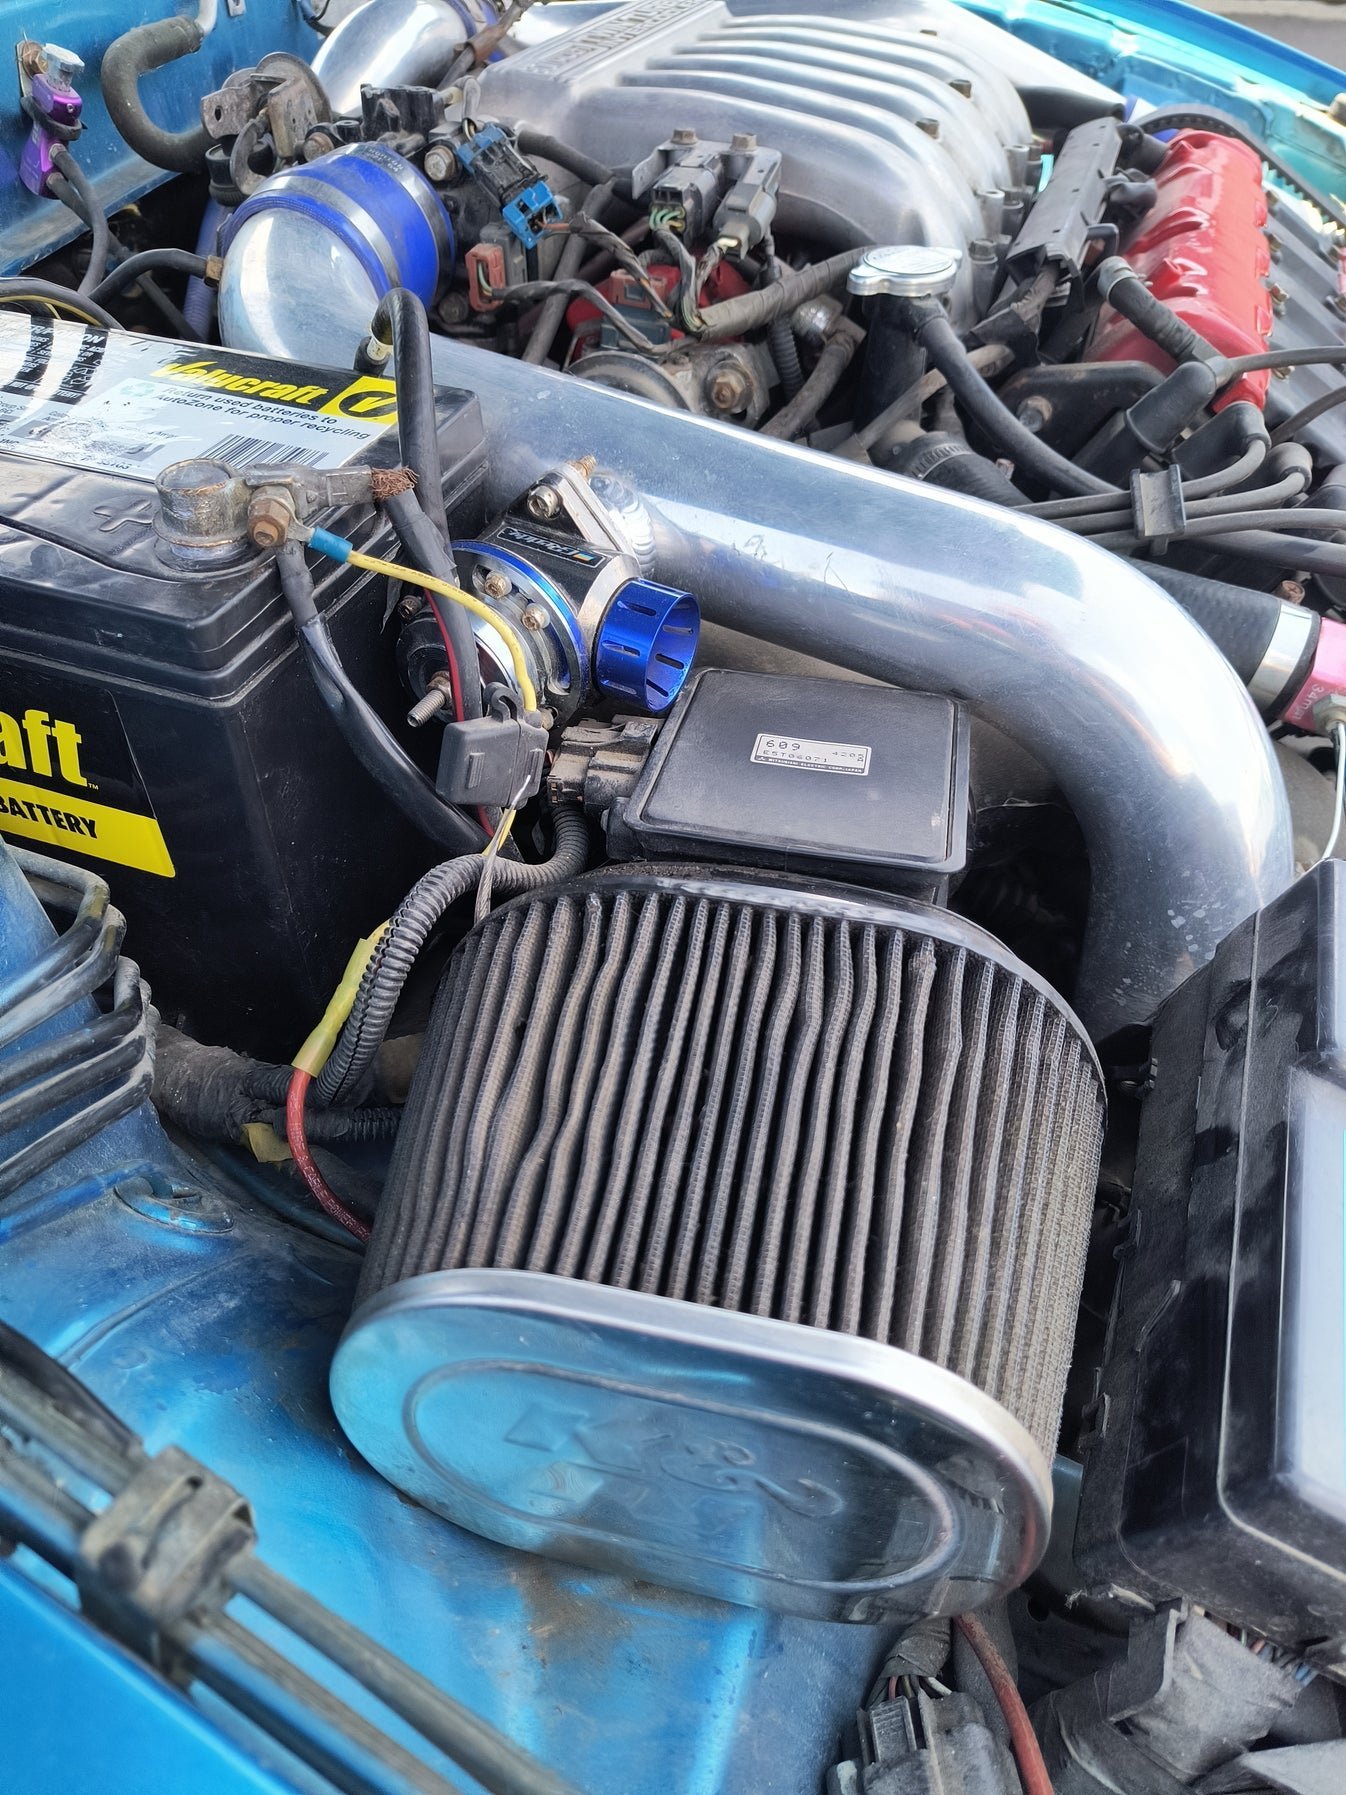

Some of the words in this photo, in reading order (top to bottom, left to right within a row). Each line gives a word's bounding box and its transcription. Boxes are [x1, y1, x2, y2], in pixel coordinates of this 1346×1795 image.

[150, 361, 329, 405] Valucraft
[156, 395, 223, 411] AutoZone
[224, 407, 248, 416] for
[245, 412, 301, 425] proper
[300, 421, 371, 440] recycling
[162, 387, 213, 401] Return
[214, 396, 254, 408] used
[252, 403, 319, 421] batteries
[320, 416, 337, 425] to
[766, 739, 800, 751] 609
